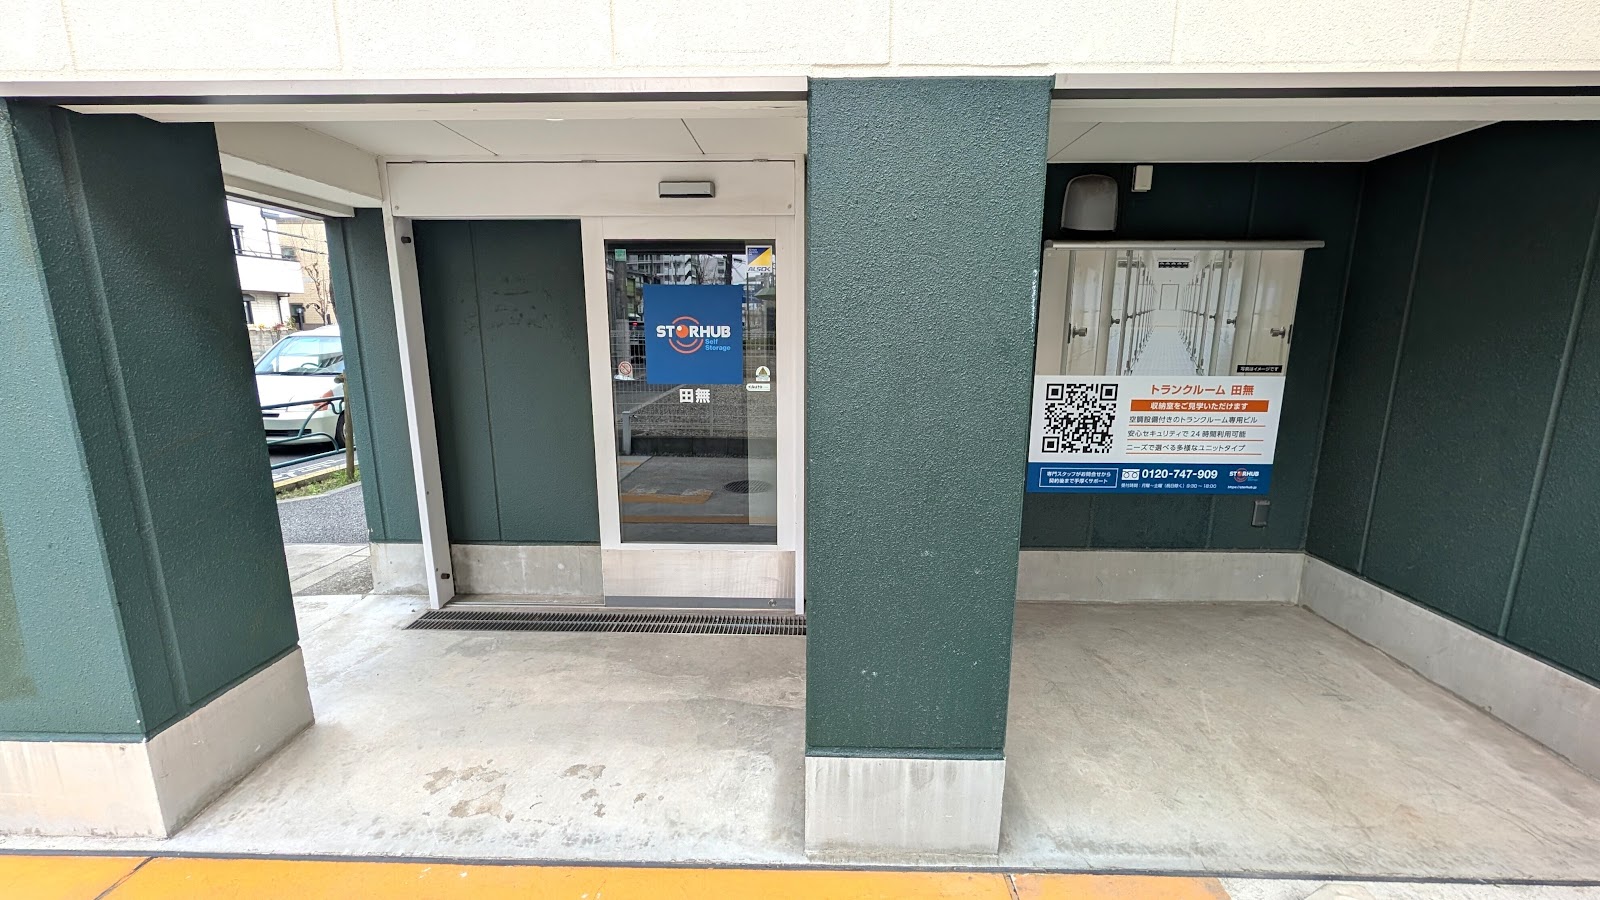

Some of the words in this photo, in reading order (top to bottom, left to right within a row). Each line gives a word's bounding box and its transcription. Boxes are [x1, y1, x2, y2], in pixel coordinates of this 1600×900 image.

[656, 325, 731, 338] STORHUB
[1151, 385, 1225, 395] トランクルーム
[1231, 385, 1254, 395] 田無
[679, 388, 710, 403] 田無
[1150, 402, 1248, 411] 収納室をご見学いただけます
[1126, 444, 1246, 452] ニーズで選べる多様なユニットタイプ
[1142, 469, 1218, 479] 0120-747-909
